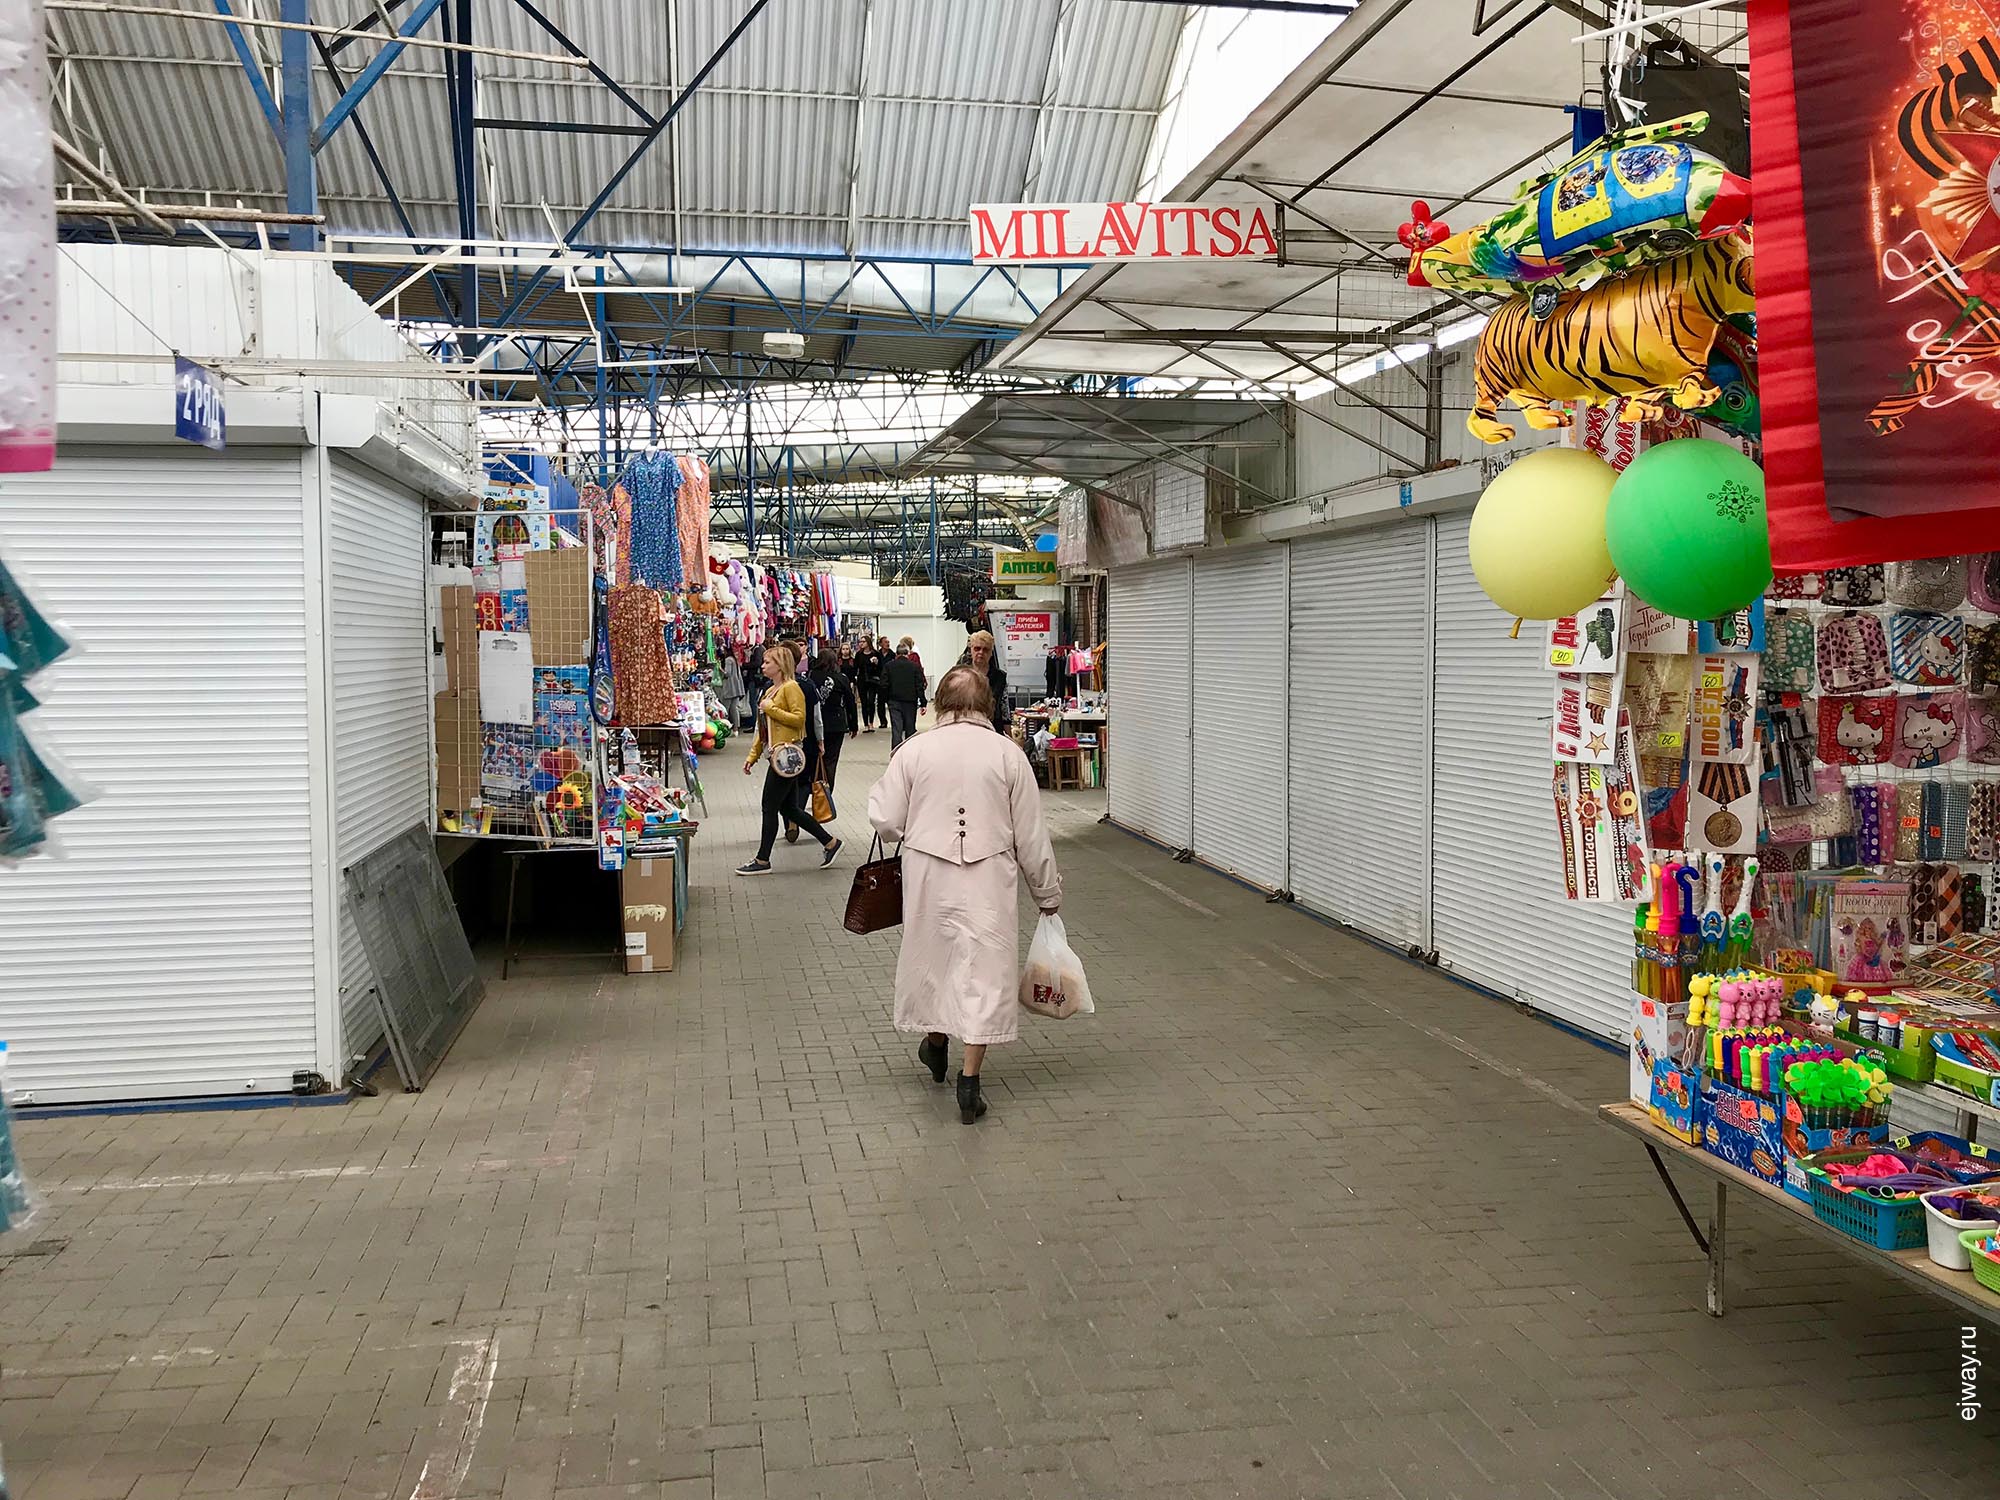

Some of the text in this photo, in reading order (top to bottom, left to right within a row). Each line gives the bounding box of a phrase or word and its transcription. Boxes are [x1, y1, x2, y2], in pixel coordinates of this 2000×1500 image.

[971, 202, 1278, 259] MILAVITSA
[183, 374, 221, 441] 2 РЯД
[1002, 561, 1056, 574] АПТЕКА
[1704, 676, 1718, 688] 60
[1556, 741, 1578, 759] С
[1561, 818, 1575, 860] МИРНОЕ
[1614, 848, 1621, 860] не
[1620, 847, 1627, 860] не
[1583, 827, 1599, 899] ГОРДИМСЯ!
